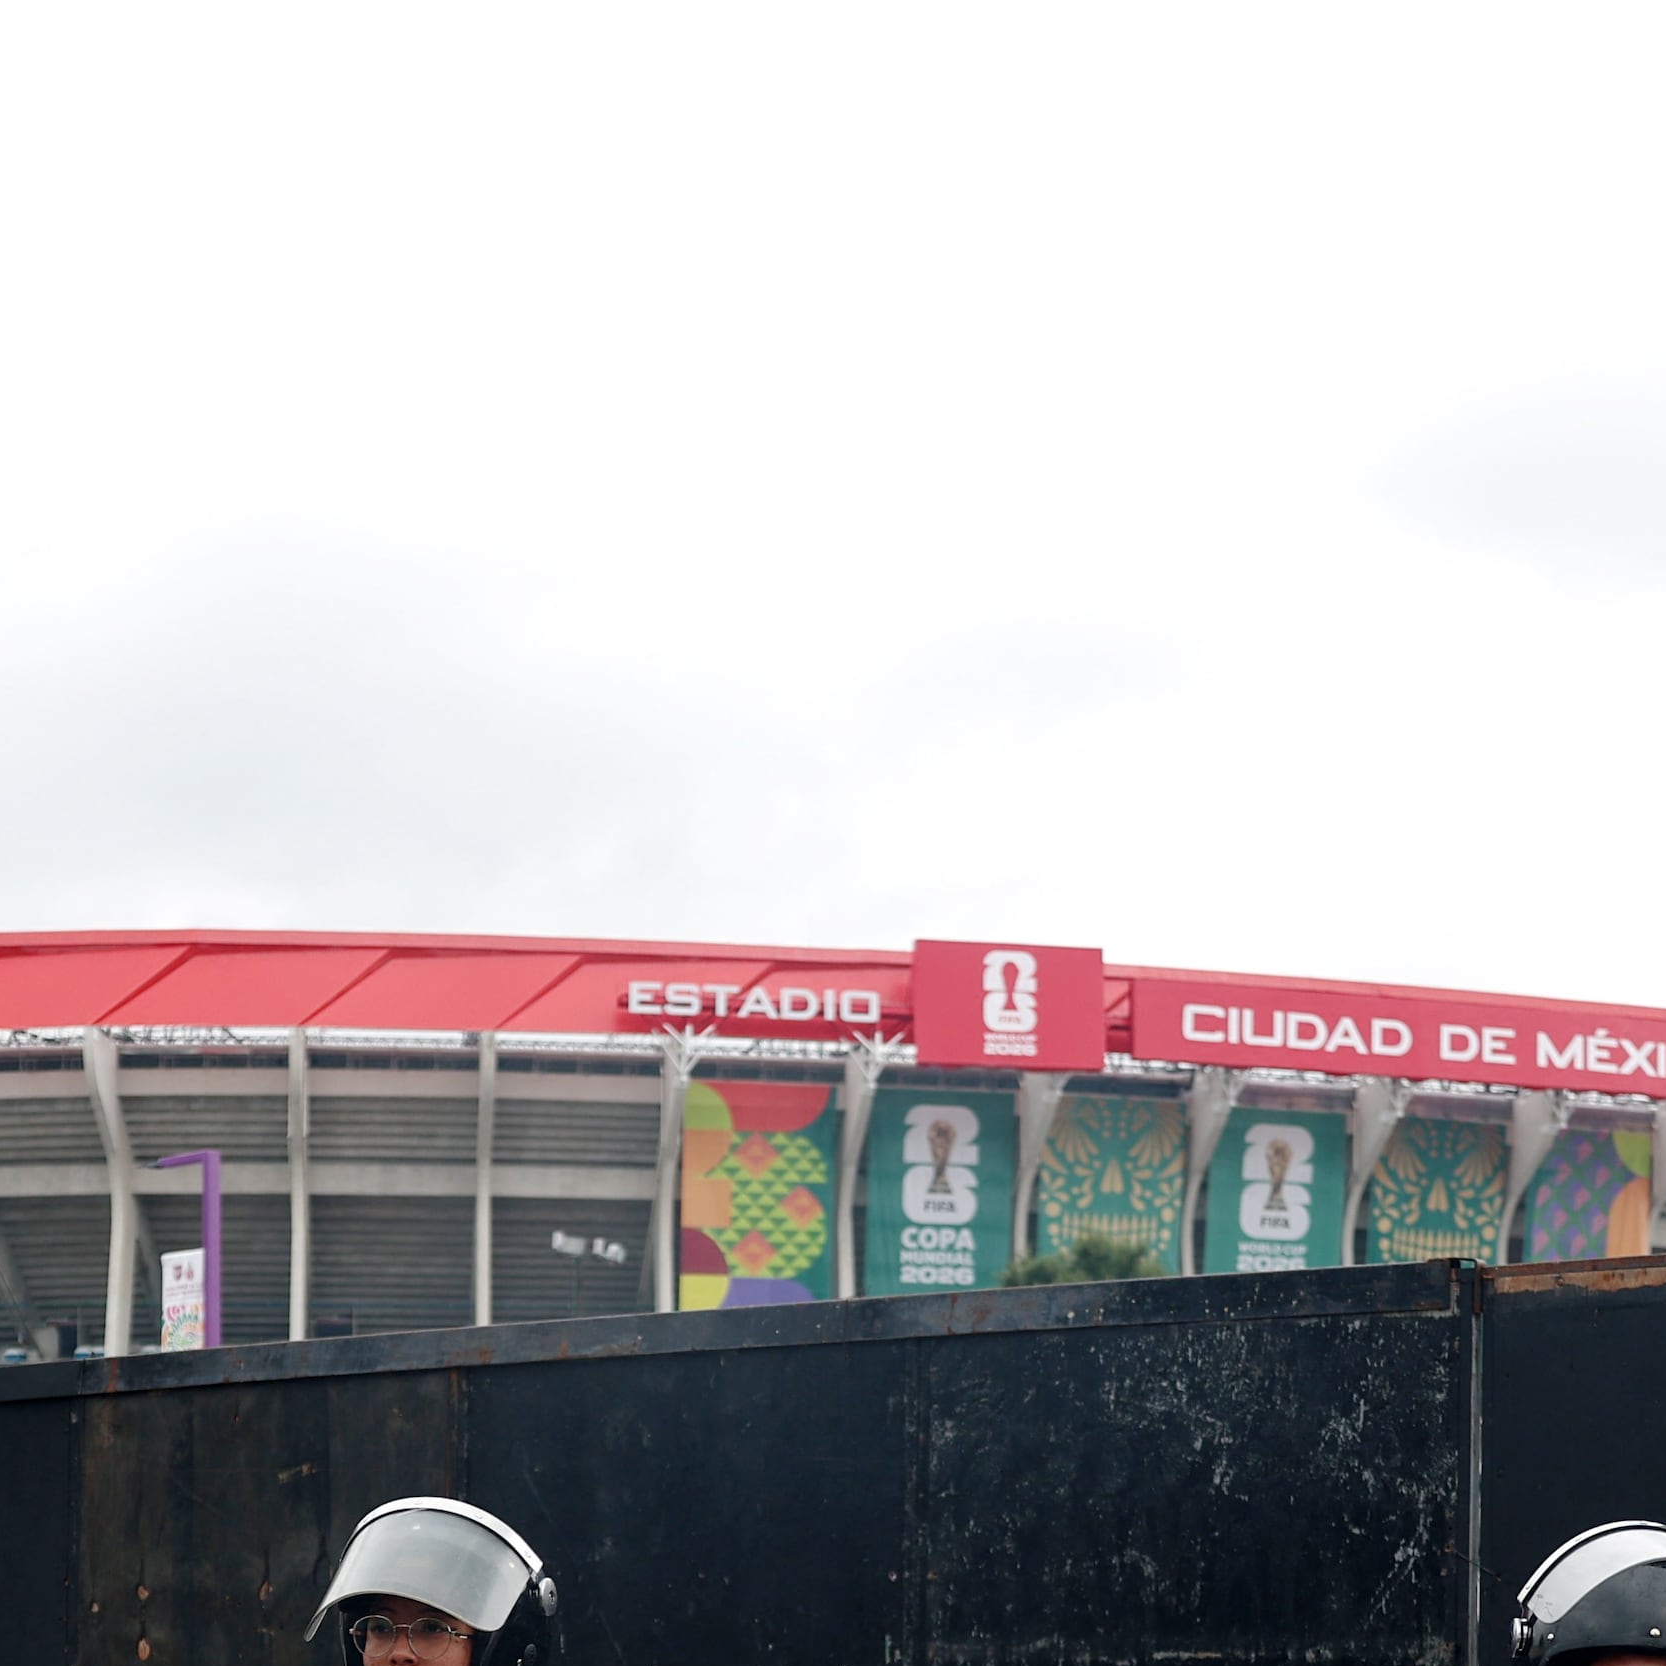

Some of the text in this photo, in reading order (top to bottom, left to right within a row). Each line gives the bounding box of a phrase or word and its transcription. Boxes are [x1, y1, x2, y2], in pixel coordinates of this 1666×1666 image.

[627, 980, 881, 1023] ESTADIO
[1182, 1003, 1413, 1057] CIUDAD
[1439, 1023, 1517, 1065] DE
[983, 1043, 1037, 1057] 2026
[901, 1227, 976, 1251] COPA
[900, 1250, 975, 1266] MUNDIAL
[900, 1266, 975, 1285] 2026
